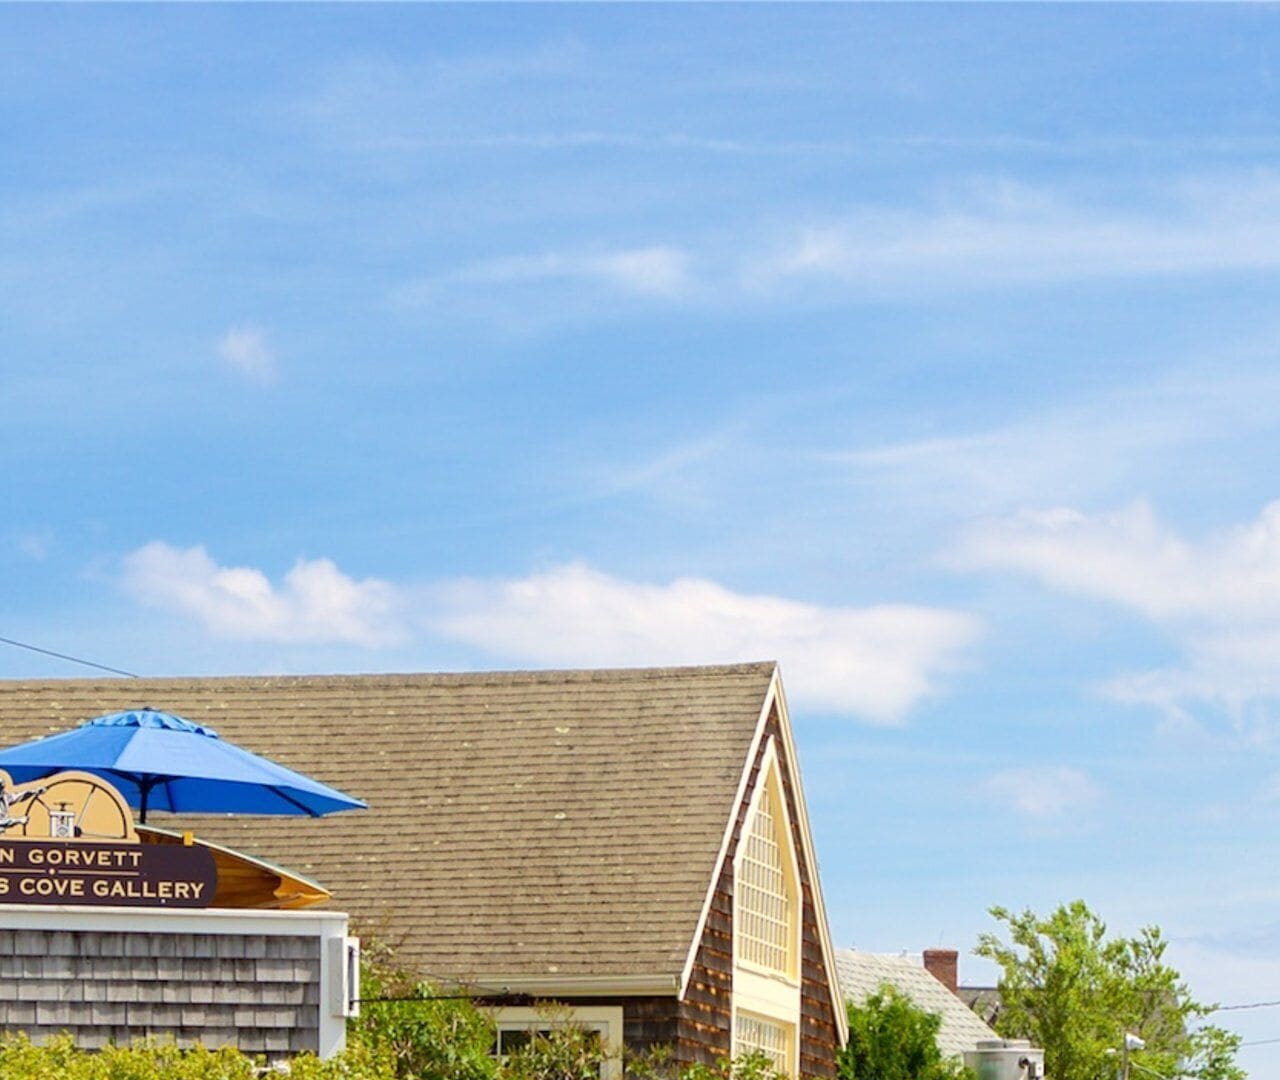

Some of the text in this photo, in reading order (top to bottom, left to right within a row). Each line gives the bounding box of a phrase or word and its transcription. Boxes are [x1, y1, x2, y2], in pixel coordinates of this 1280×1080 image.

[28, 849, 143, 867] GORVETT
[19, 878, 86, 897] COVE
[92, 880, 205, 899] GALLERY
